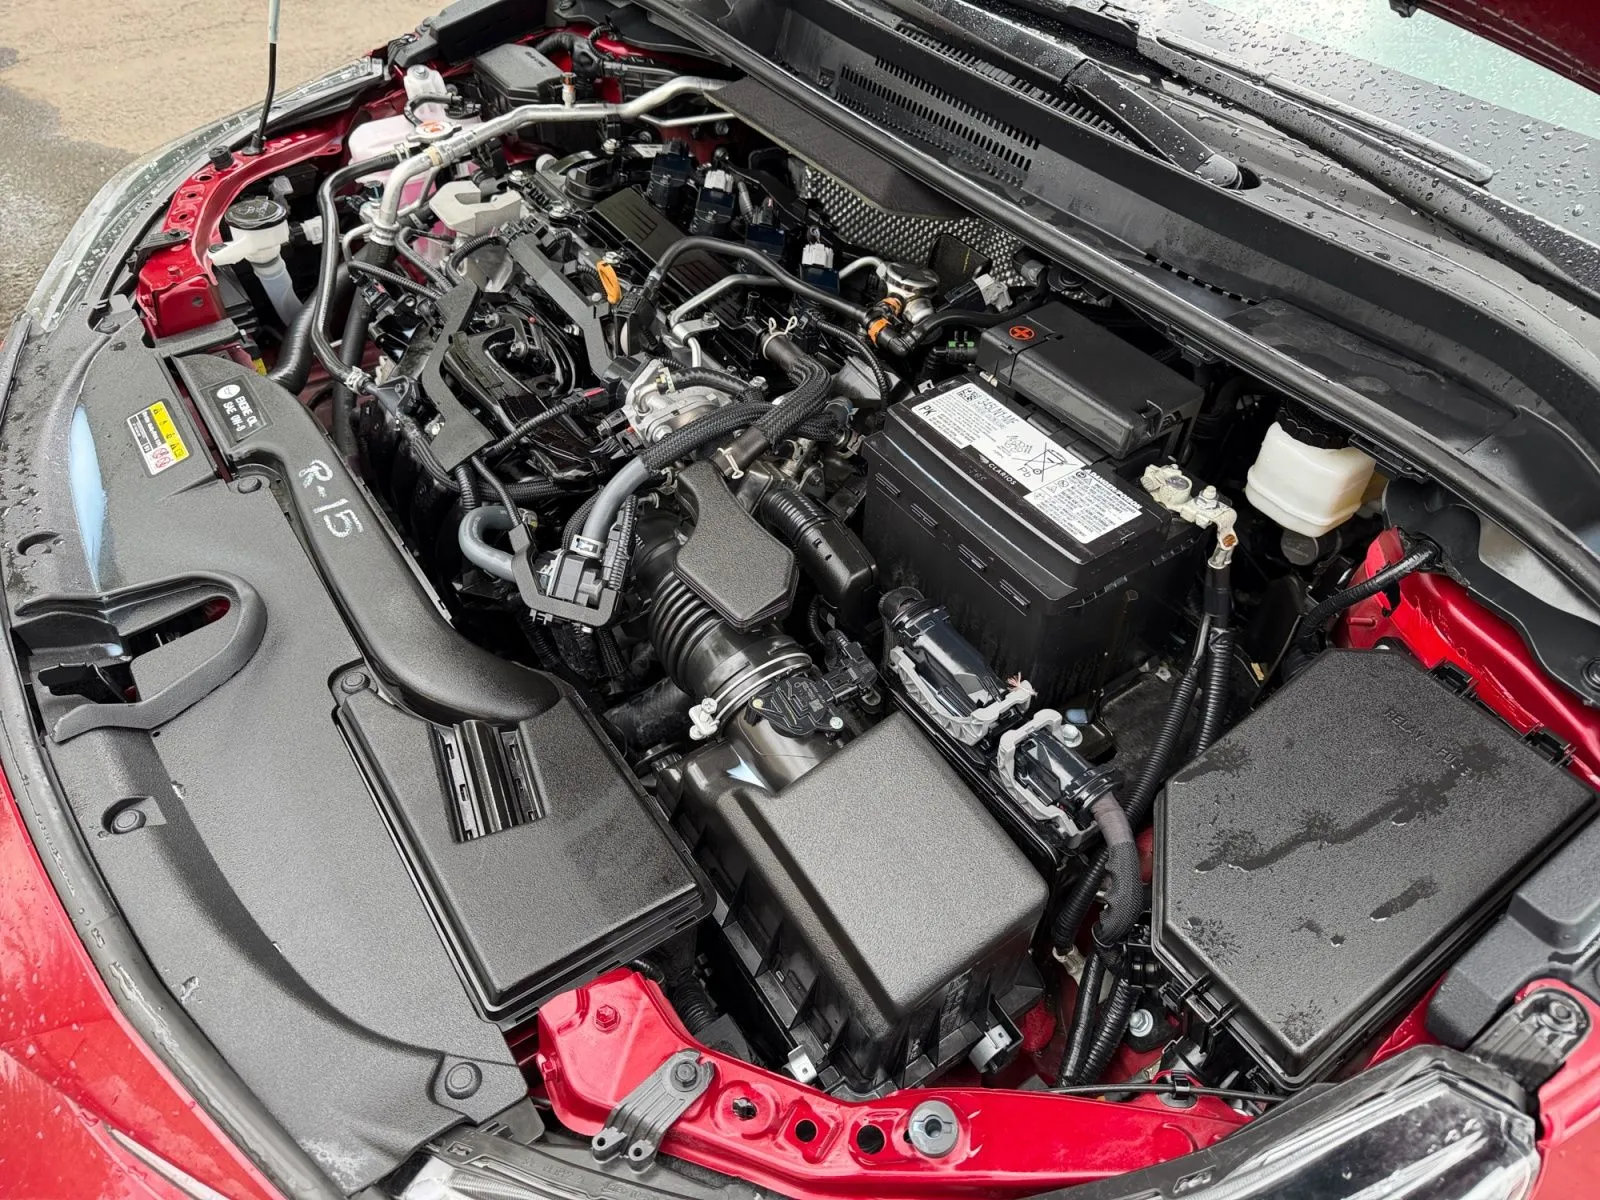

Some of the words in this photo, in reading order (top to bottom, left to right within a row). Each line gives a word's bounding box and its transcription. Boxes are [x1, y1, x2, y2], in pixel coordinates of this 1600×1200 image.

[222, 401, 237, 415] SAE
[919, 404, 937, 417] PK
[246, 415, 258, 427] OIL
[988, 463, 1017, 486] CLARIOS
[1017, 466, 1031, 478] Pb
[299, 460, 363, 537] R-15
[1384, 708, 1428, 741] RELAY
